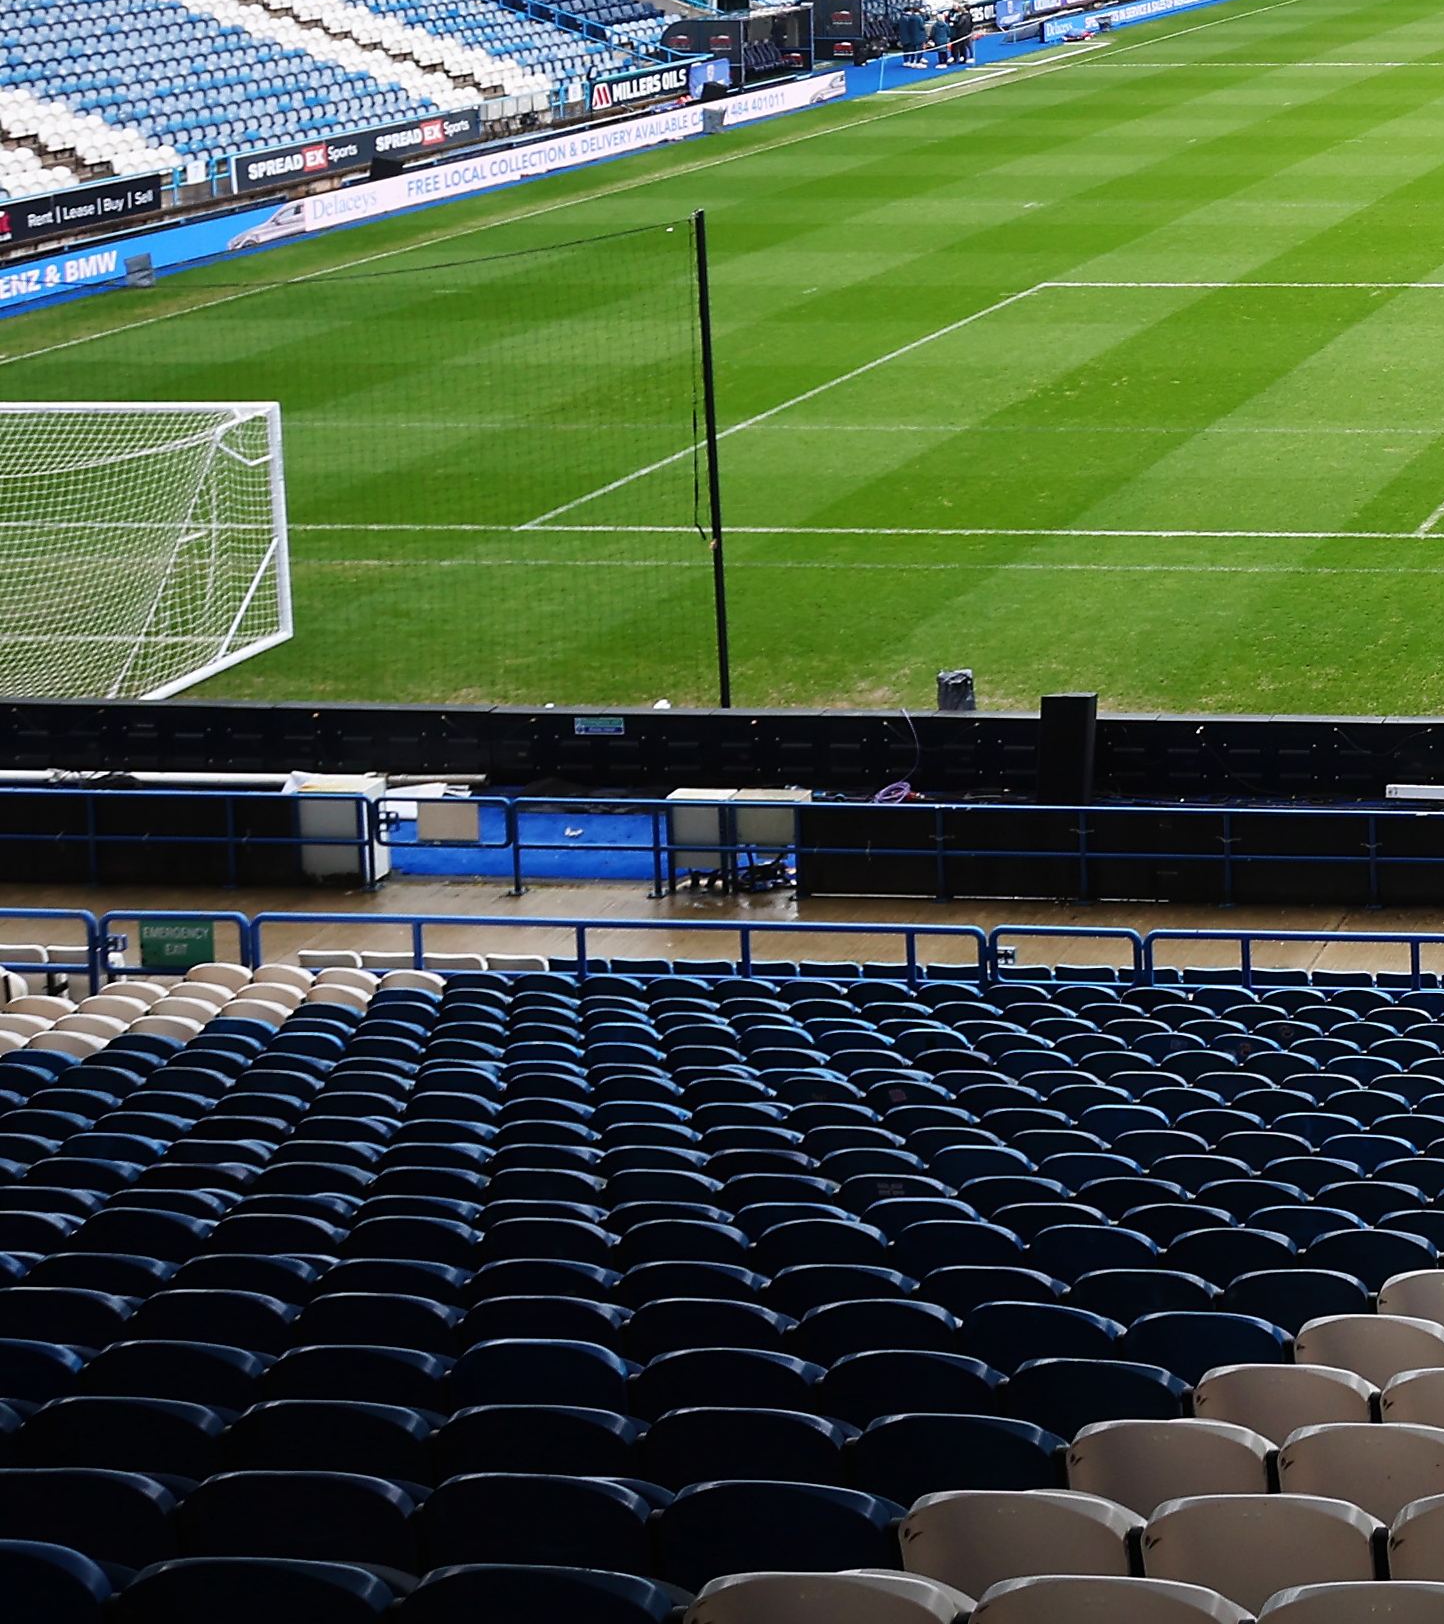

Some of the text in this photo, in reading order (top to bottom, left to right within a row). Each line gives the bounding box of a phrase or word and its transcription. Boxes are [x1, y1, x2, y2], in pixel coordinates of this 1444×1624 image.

[613, 68, 687, 102] MILLERS OILS
[443, 119, 469, 136] Sports
[312, 190, 377, 220] Delaceys
[406, 176, 441, 197] FREE
[445, 164, 487, 188] LOCAL
[489, 144, 567, 178] COLLECTION
[569, 139, 579, 157] &
[580, 128, 633, 155] DELIVERY
[635, 116, 688, 142] AVAILABLE
[751, 92, 785, 111] 401011
[327, 143, 358, 162] Sports
[27, 190, 153, 227] Rent Lease Buy Sell
[46, 265, 60, 284] &
[65, 250, 117, 281] BMW
[143, 927, 209, 940] EMERGENCY
[164, 943, 188, 956] EXIT
